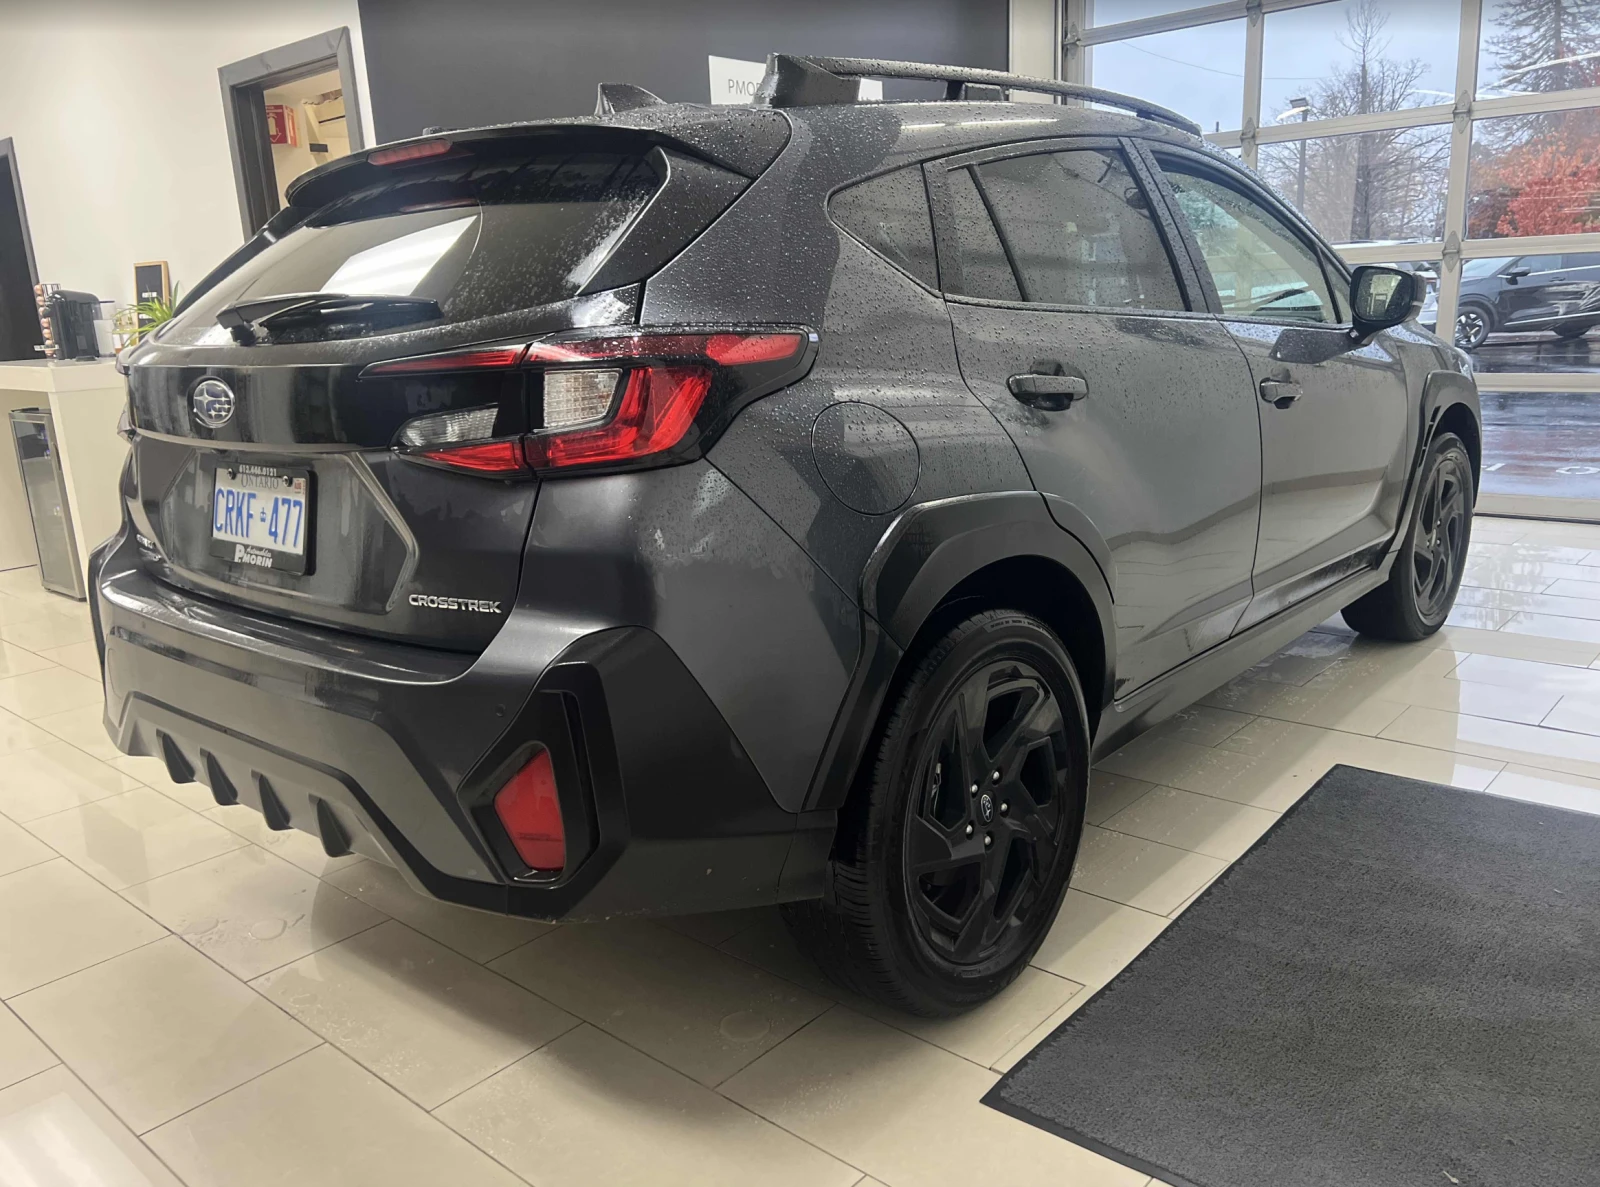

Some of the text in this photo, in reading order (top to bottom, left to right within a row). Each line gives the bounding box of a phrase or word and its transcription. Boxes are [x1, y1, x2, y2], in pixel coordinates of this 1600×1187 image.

[214, 488, 303, 548] CRKF 477
[408, 594, 502, 613] CROSSTREK
